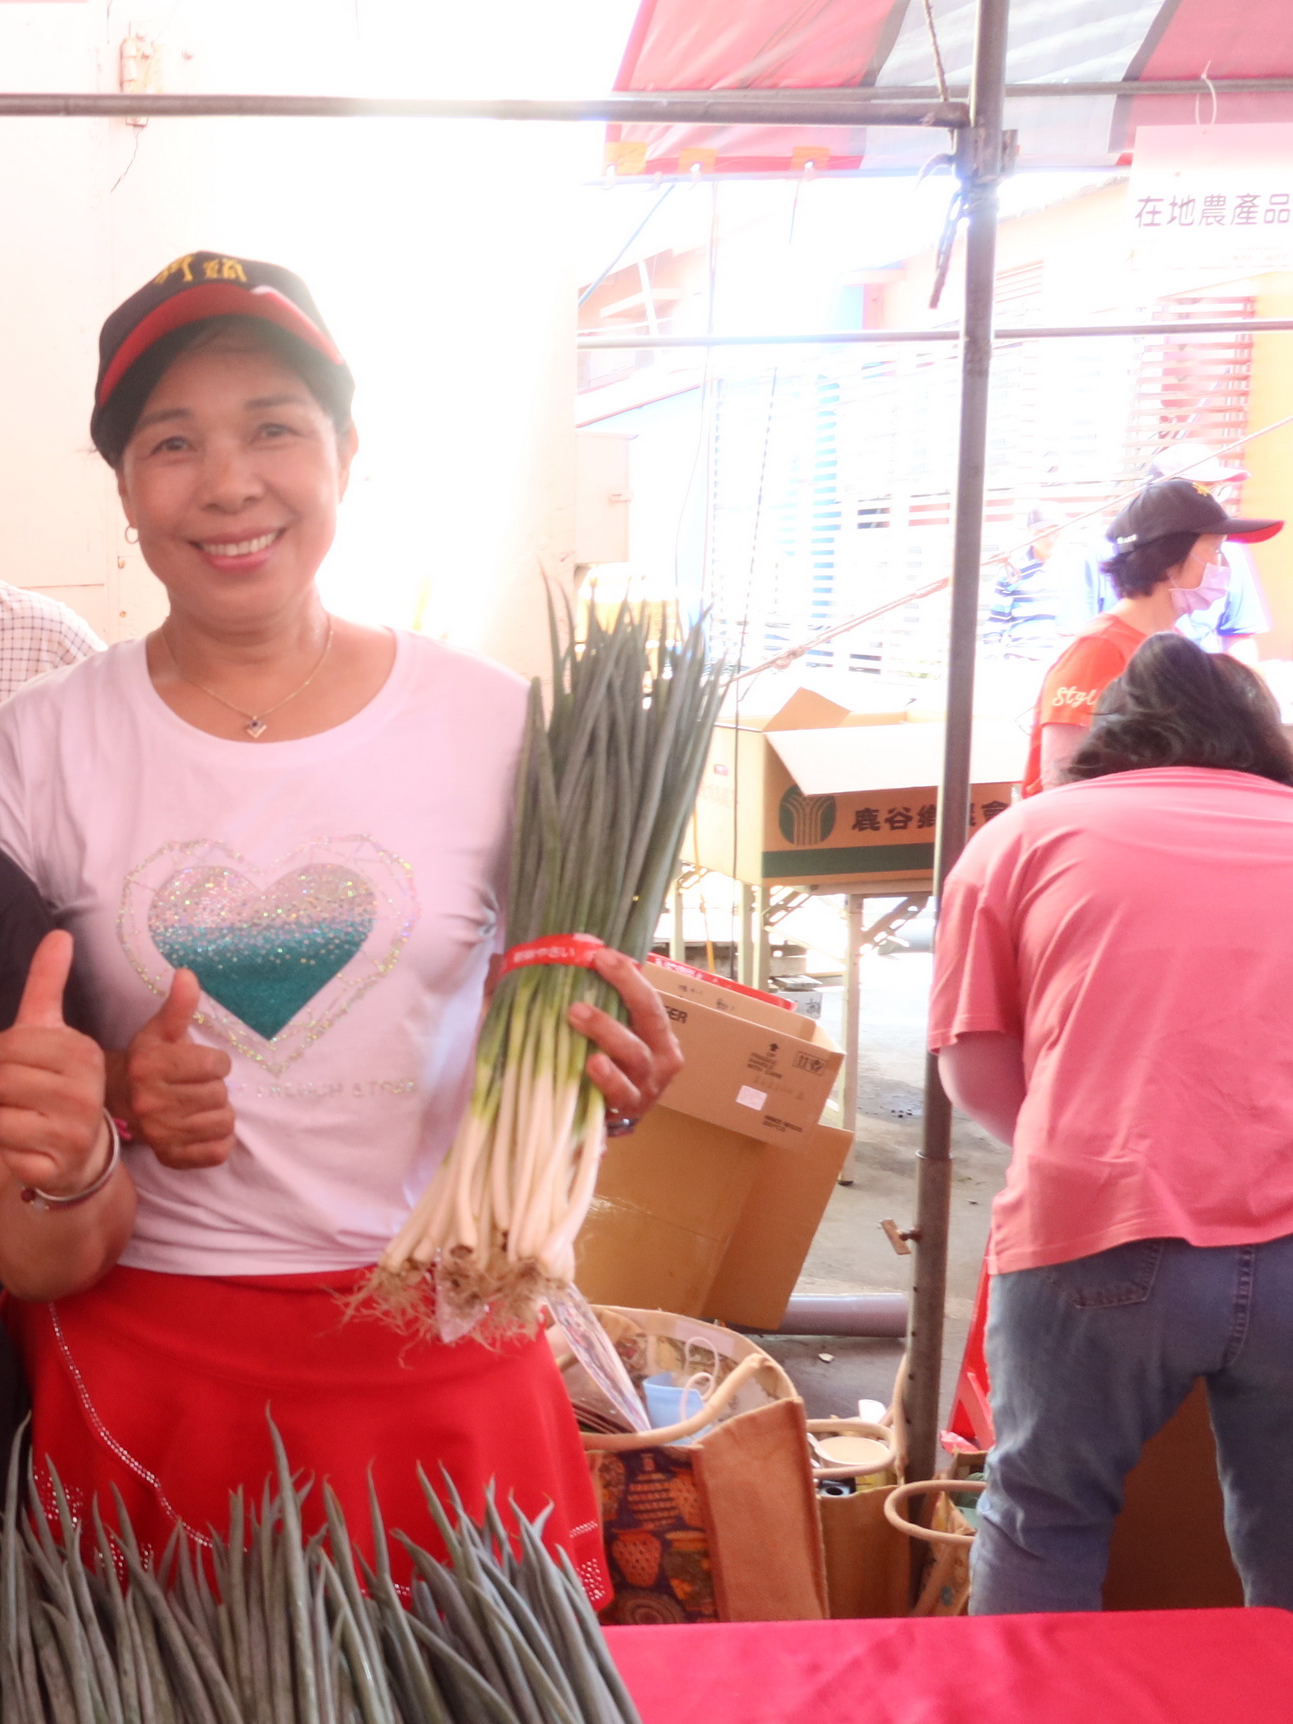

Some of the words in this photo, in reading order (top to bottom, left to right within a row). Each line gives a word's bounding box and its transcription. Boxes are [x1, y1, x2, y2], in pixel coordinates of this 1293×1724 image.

[1134, 193, 1291, 228] 在地農產品
[850, 800, 1011, 833] 鹿谷鄉會
[665, 1005, 688, 1024] ER
